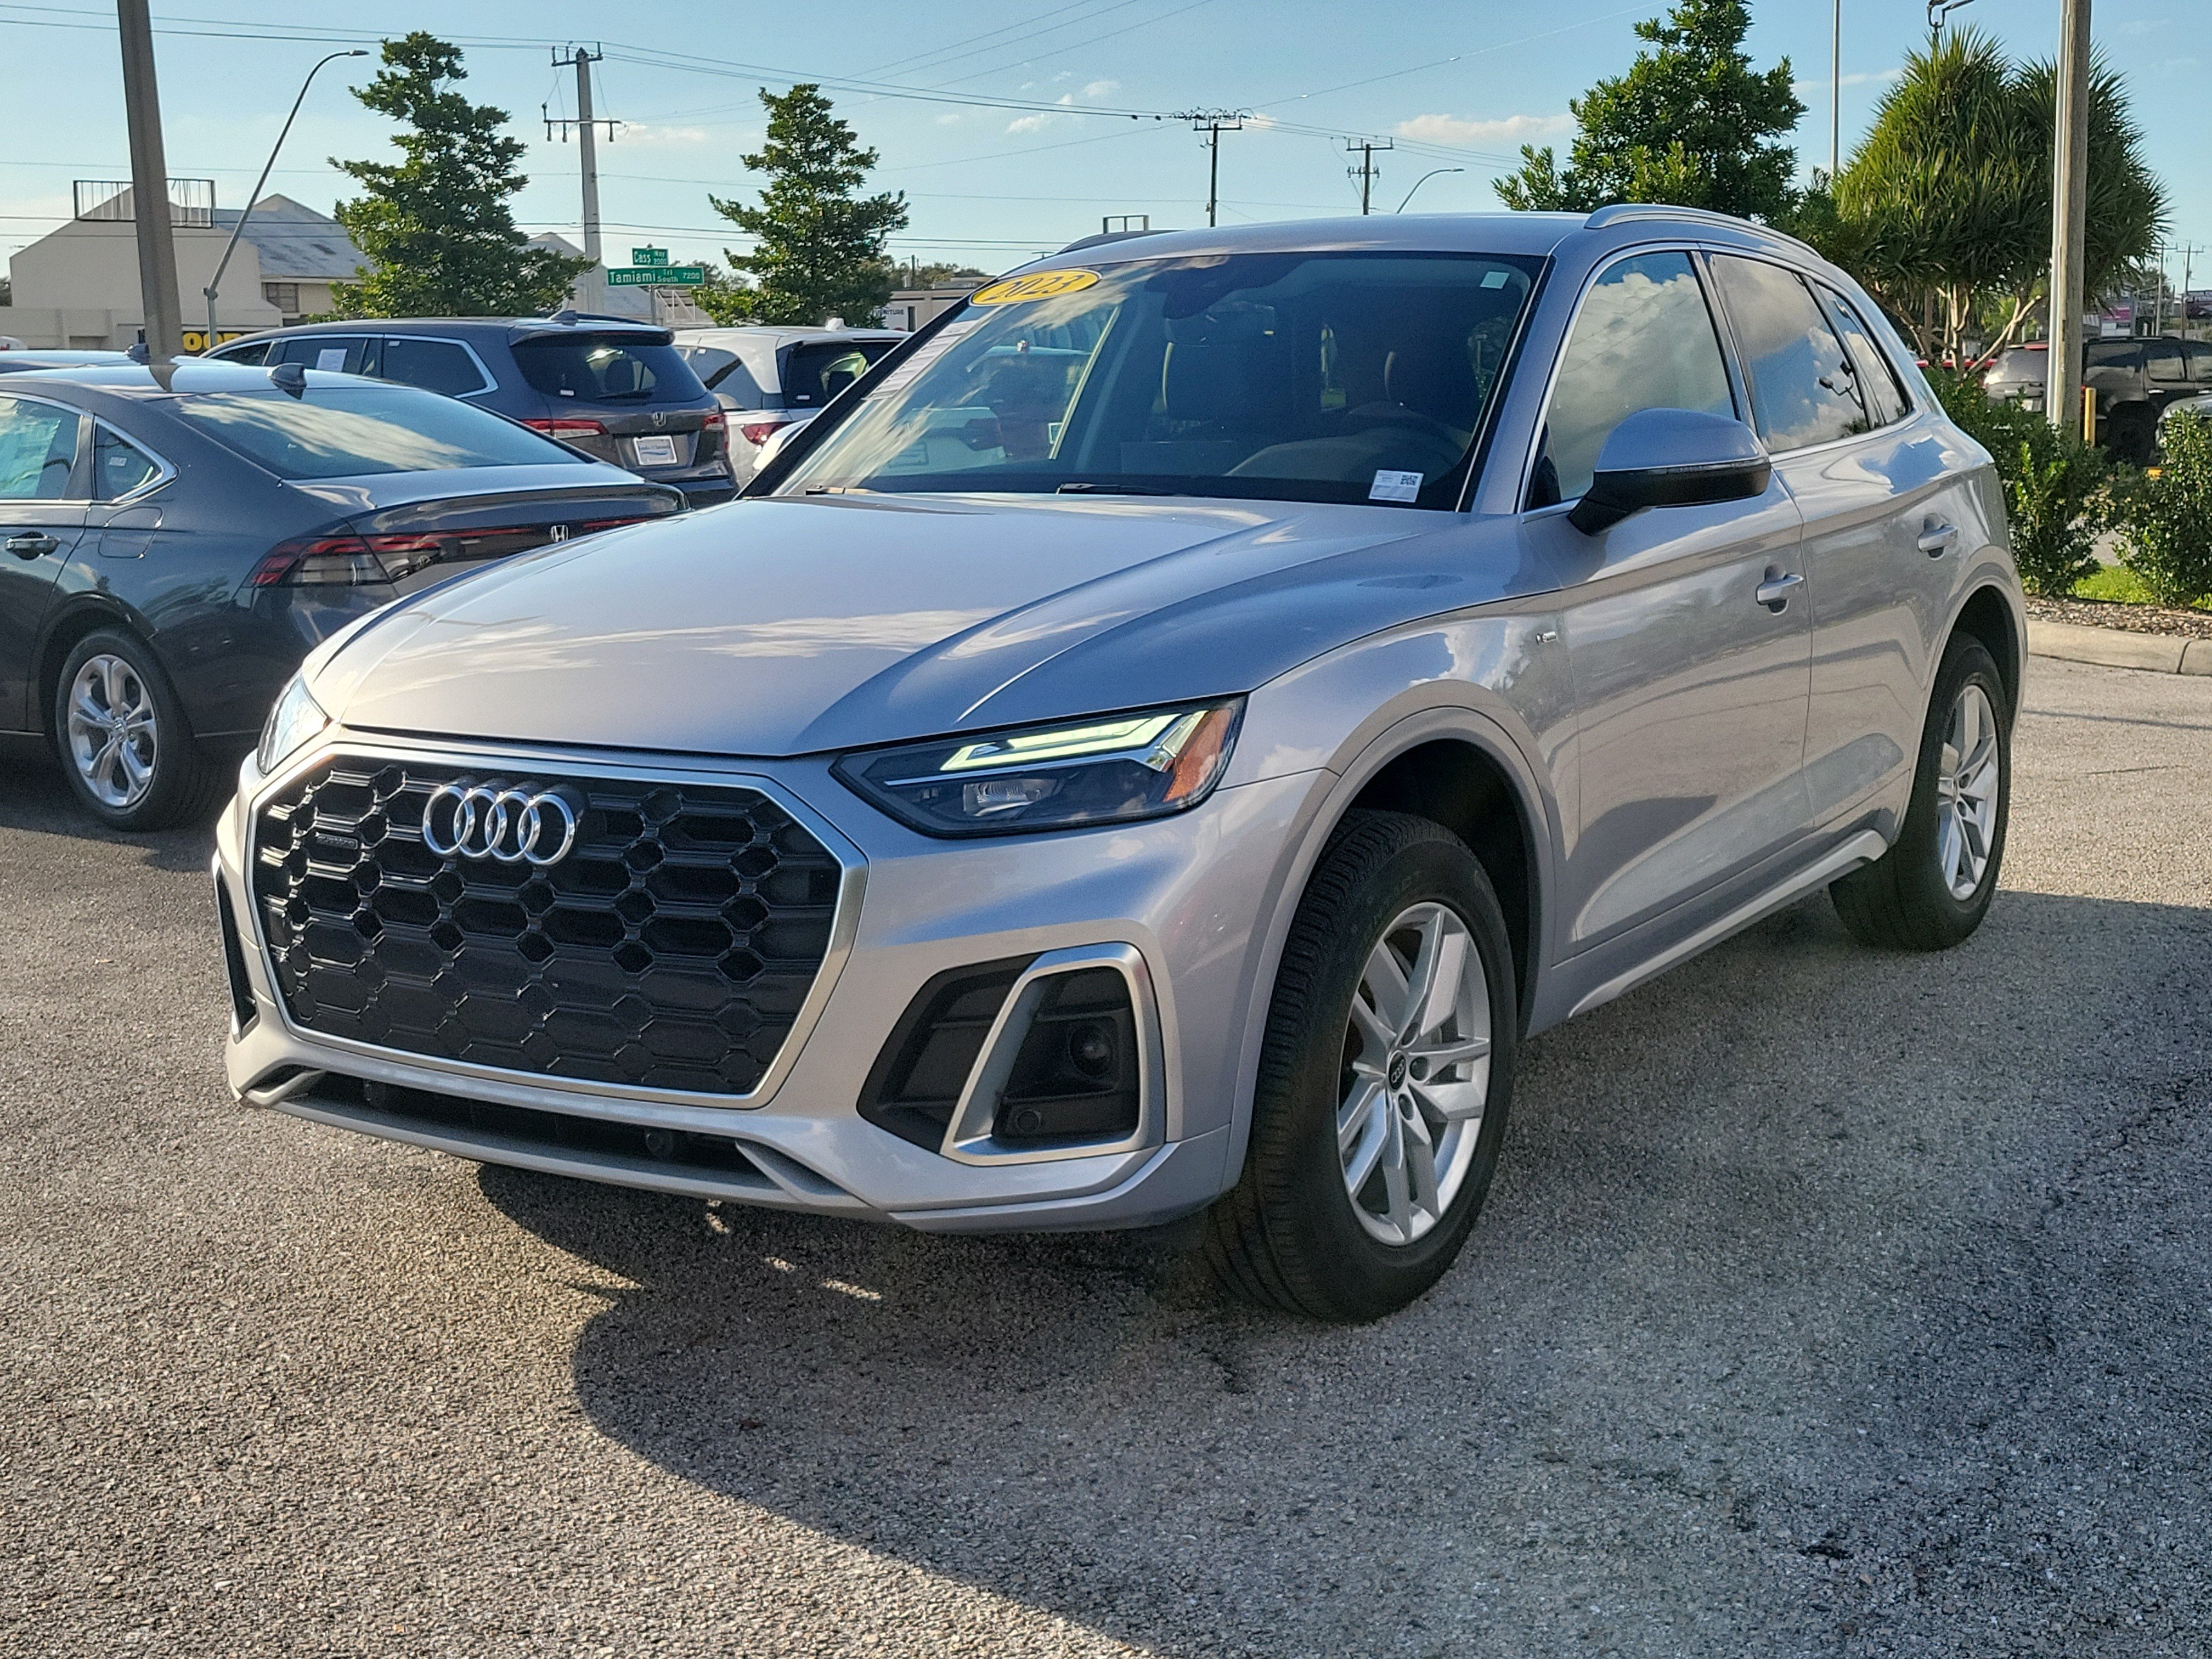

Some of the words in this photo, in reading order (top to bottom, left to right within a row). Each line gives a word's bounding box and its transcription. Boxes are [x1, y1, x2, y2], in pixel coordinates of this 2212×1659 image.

[634, 251, 651, 263] Cass
[610, 270, 656, 283] Tamiami
[982, 275, 1086, 301] 2023
